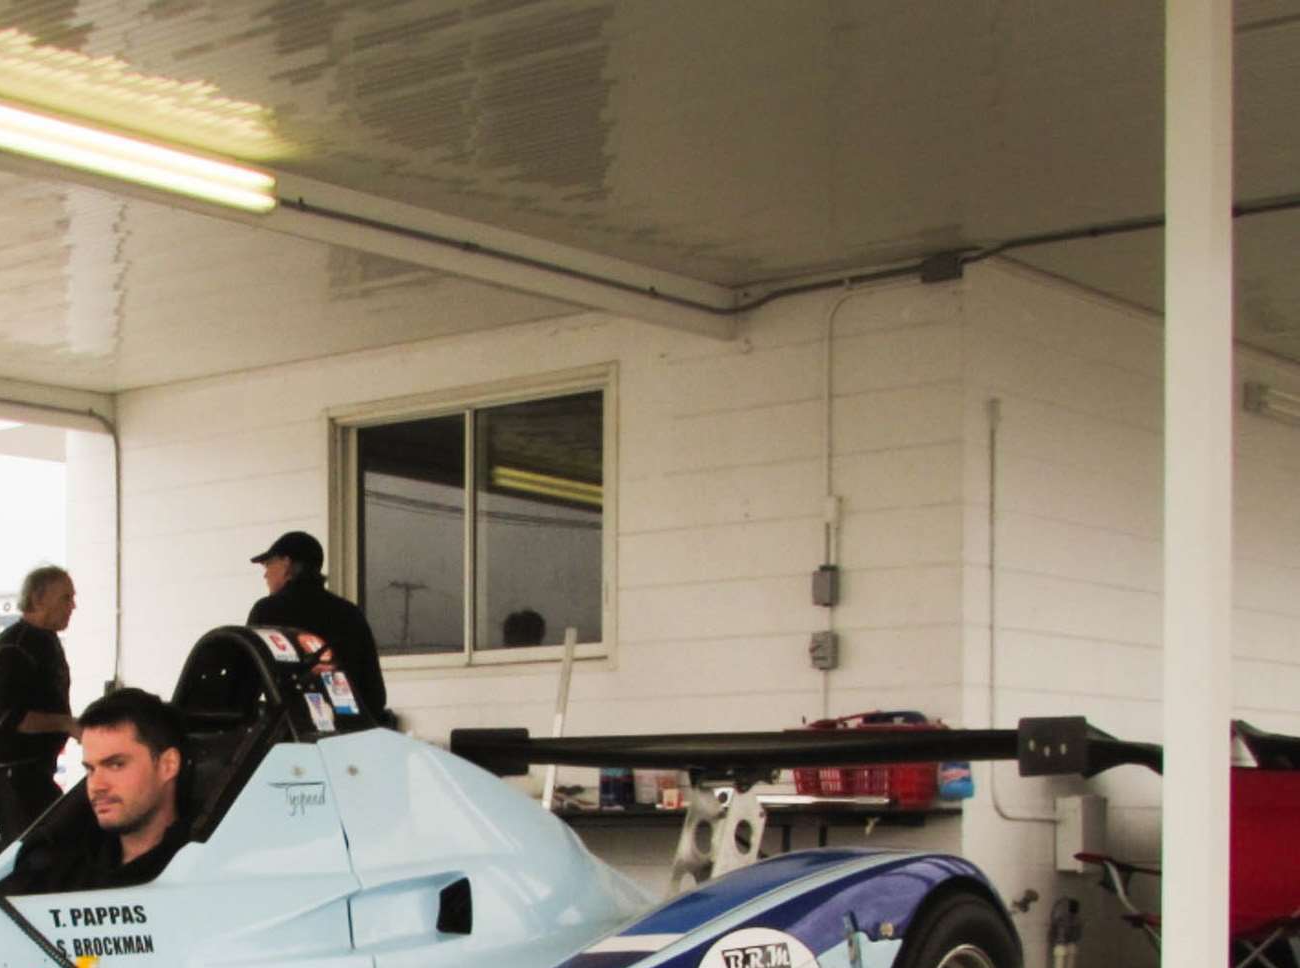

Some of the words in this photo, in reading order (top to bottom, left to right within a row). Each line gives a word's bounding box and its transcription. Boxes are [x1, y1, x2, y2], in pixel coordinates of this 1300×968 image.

[48, 909, 67, 928] T.
[69, 905, 147, 927] PAPPAS
[73, 935, 154, 957] BROCKMAN
